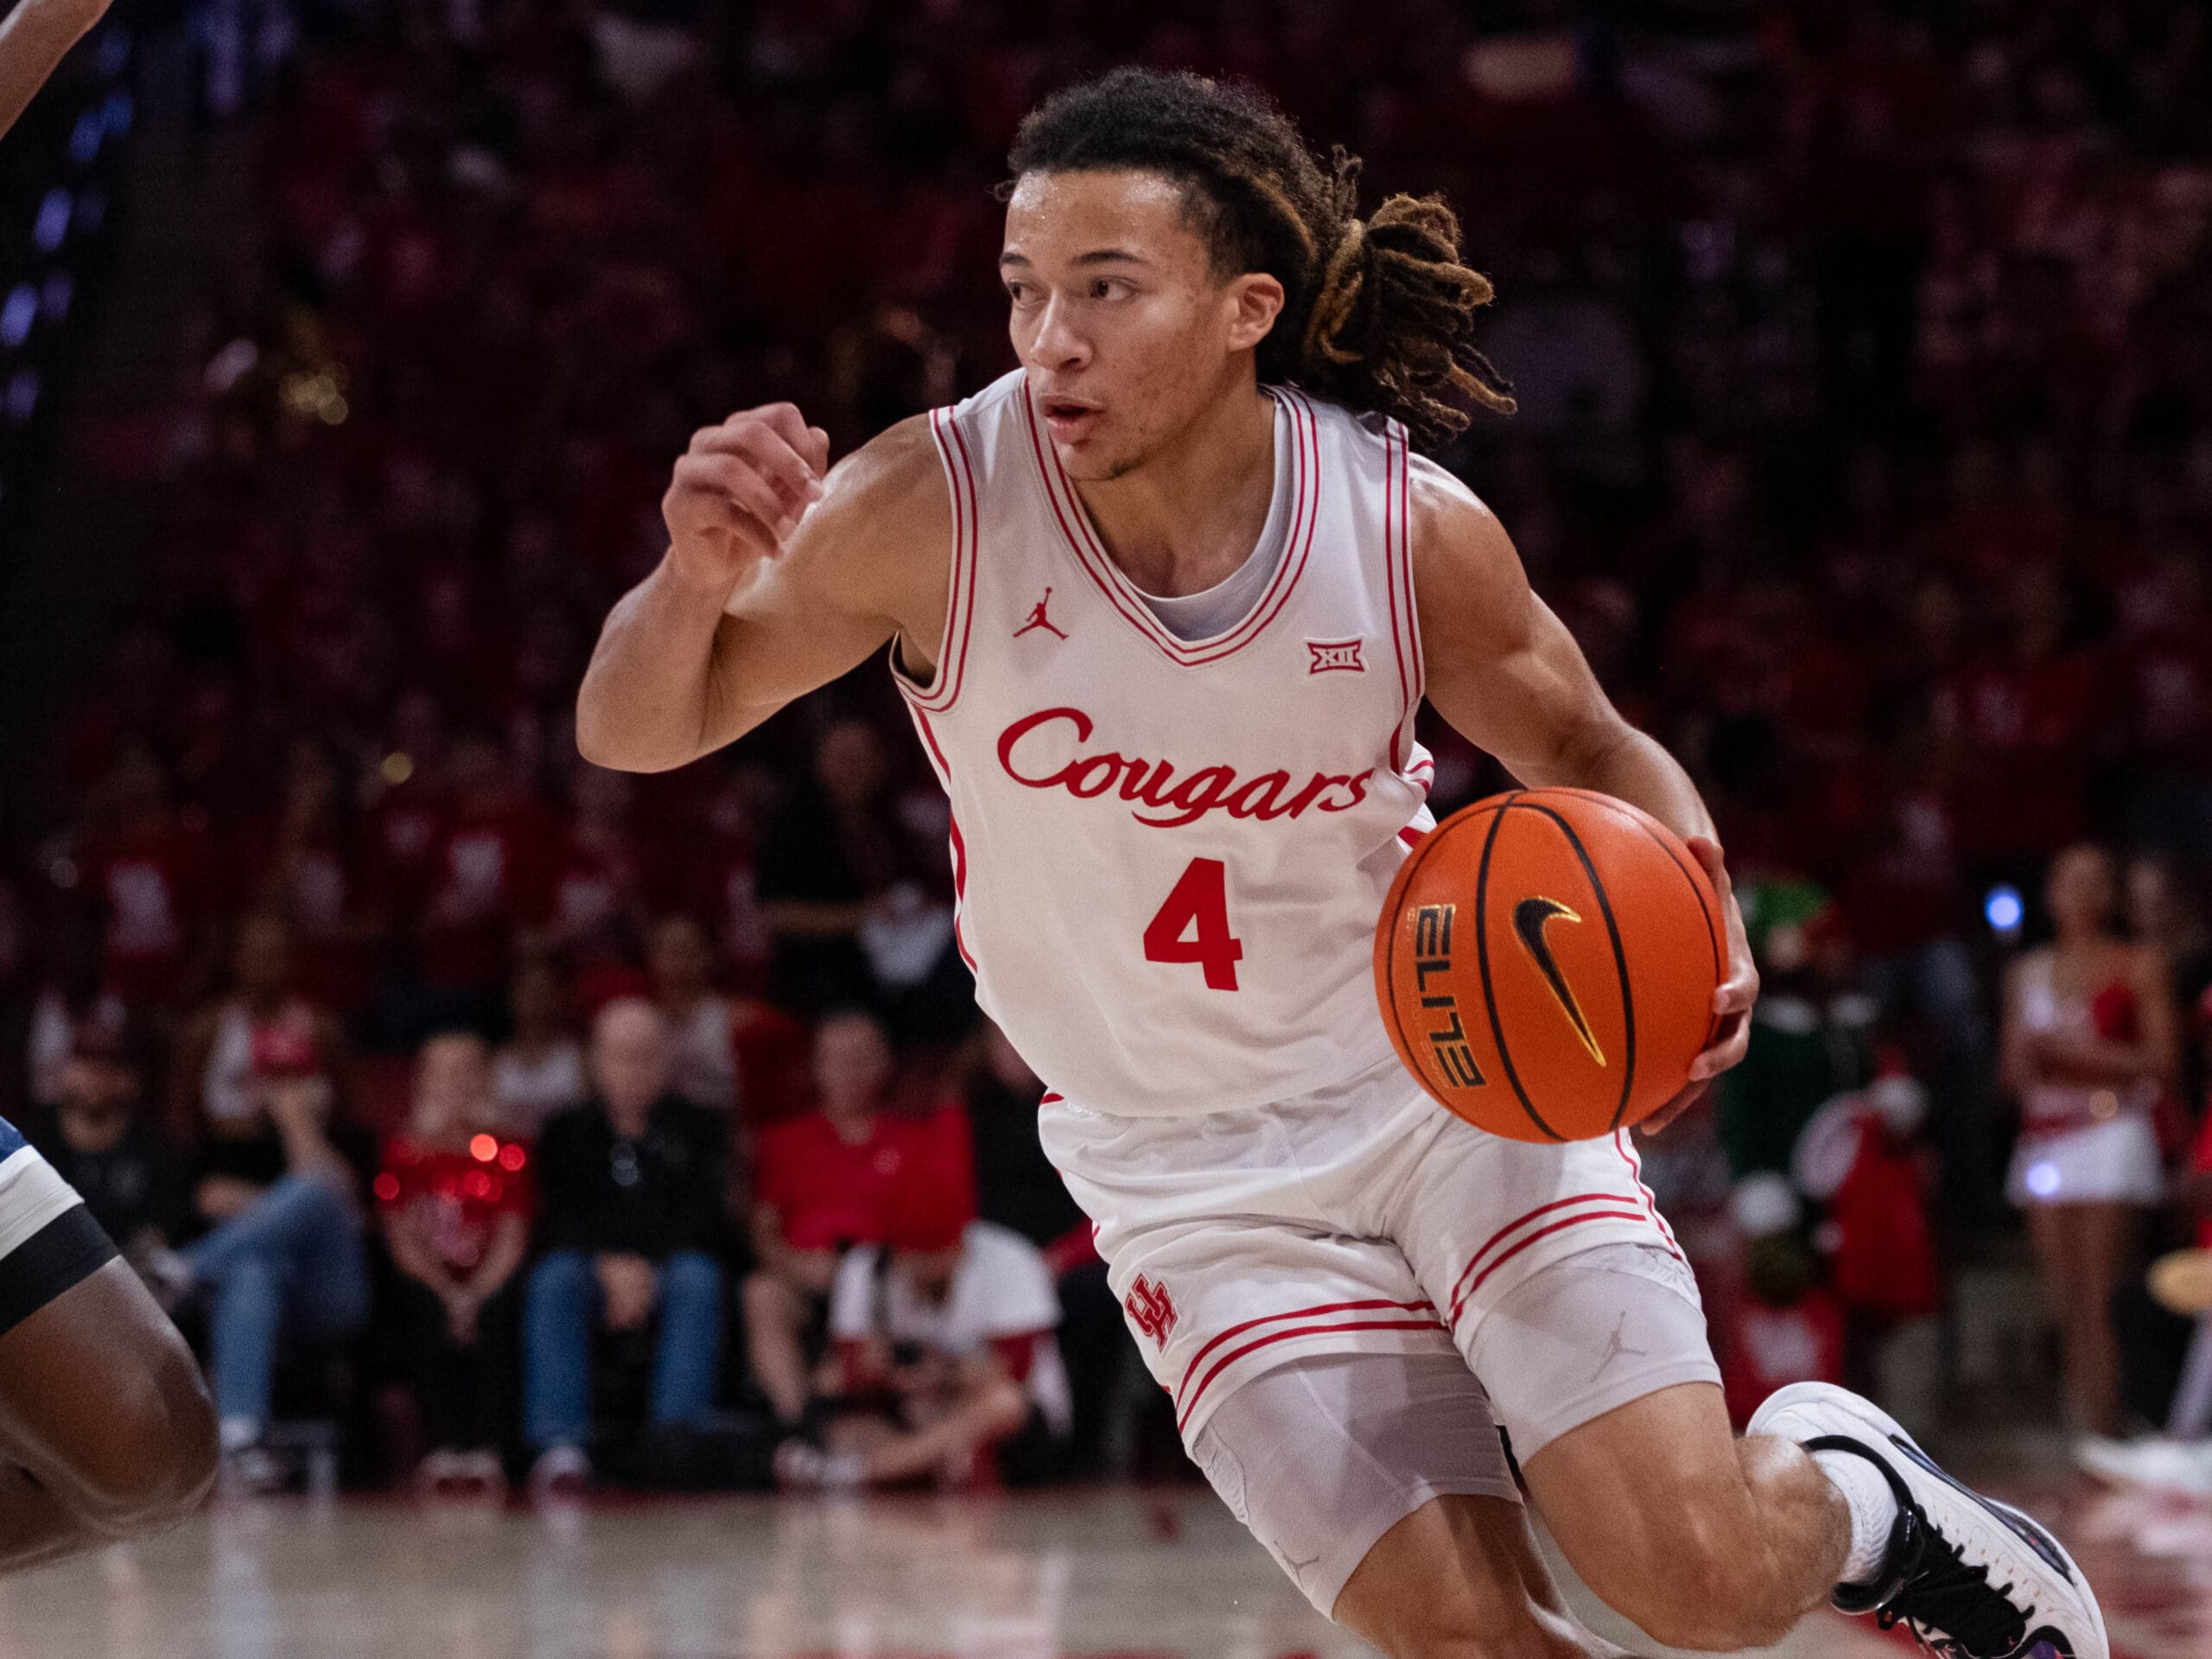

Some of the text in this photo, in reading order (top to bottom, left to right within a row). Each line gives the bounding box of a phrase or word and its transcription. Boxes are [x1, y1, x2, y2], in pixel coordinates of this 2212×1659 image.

[1311, 645, 1360, 671] XII
[997, 707, 1374, 828] Cougars
[1143, 857, 1243, 992] 4
[1416, 905, 1486, 1088] ELITE
